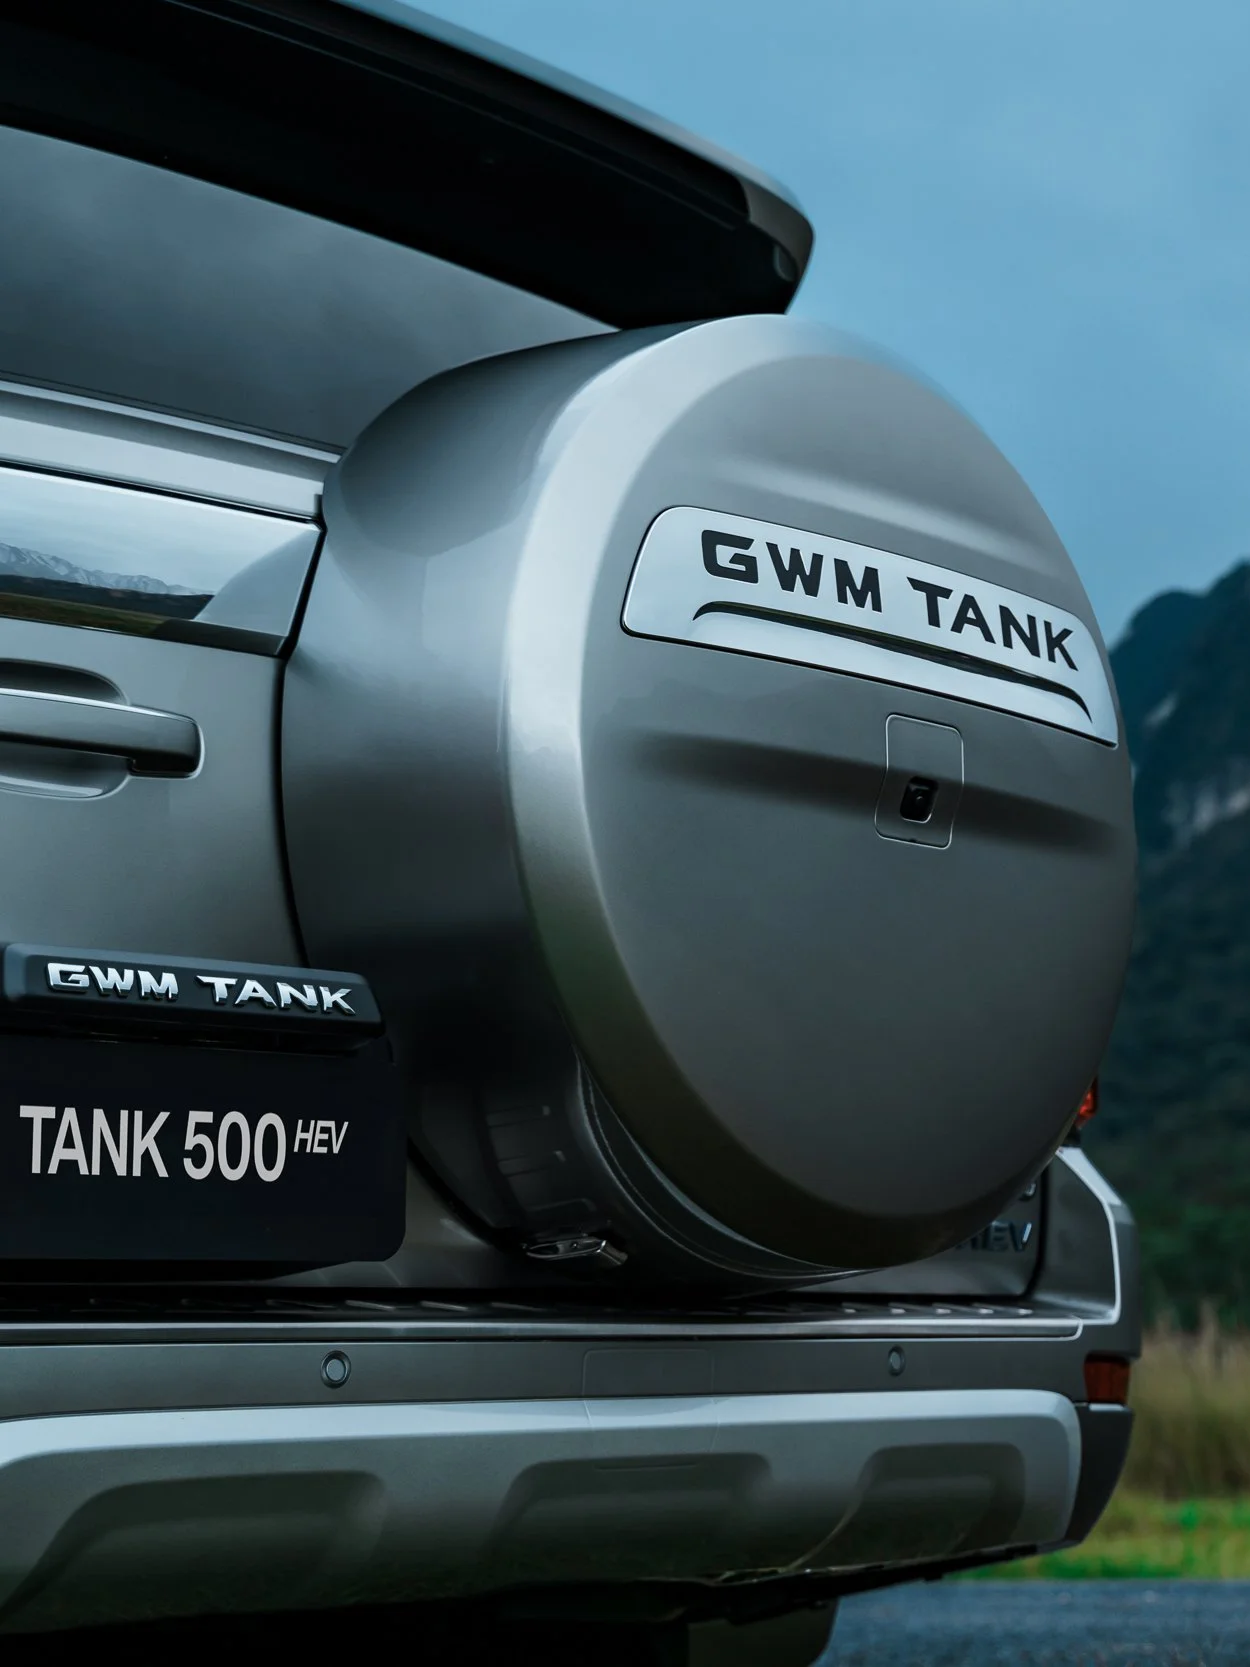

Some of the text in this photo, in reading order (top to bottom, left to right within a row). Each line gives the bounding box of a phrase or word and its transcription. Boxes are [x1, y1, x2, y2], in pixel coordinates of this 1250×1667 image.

[700, 529, 1079, 672] GWM TANK
[46, 962, 356, 1015] GWM TANK
[19, 1104, 349, 1182] TANK 500 HEV
